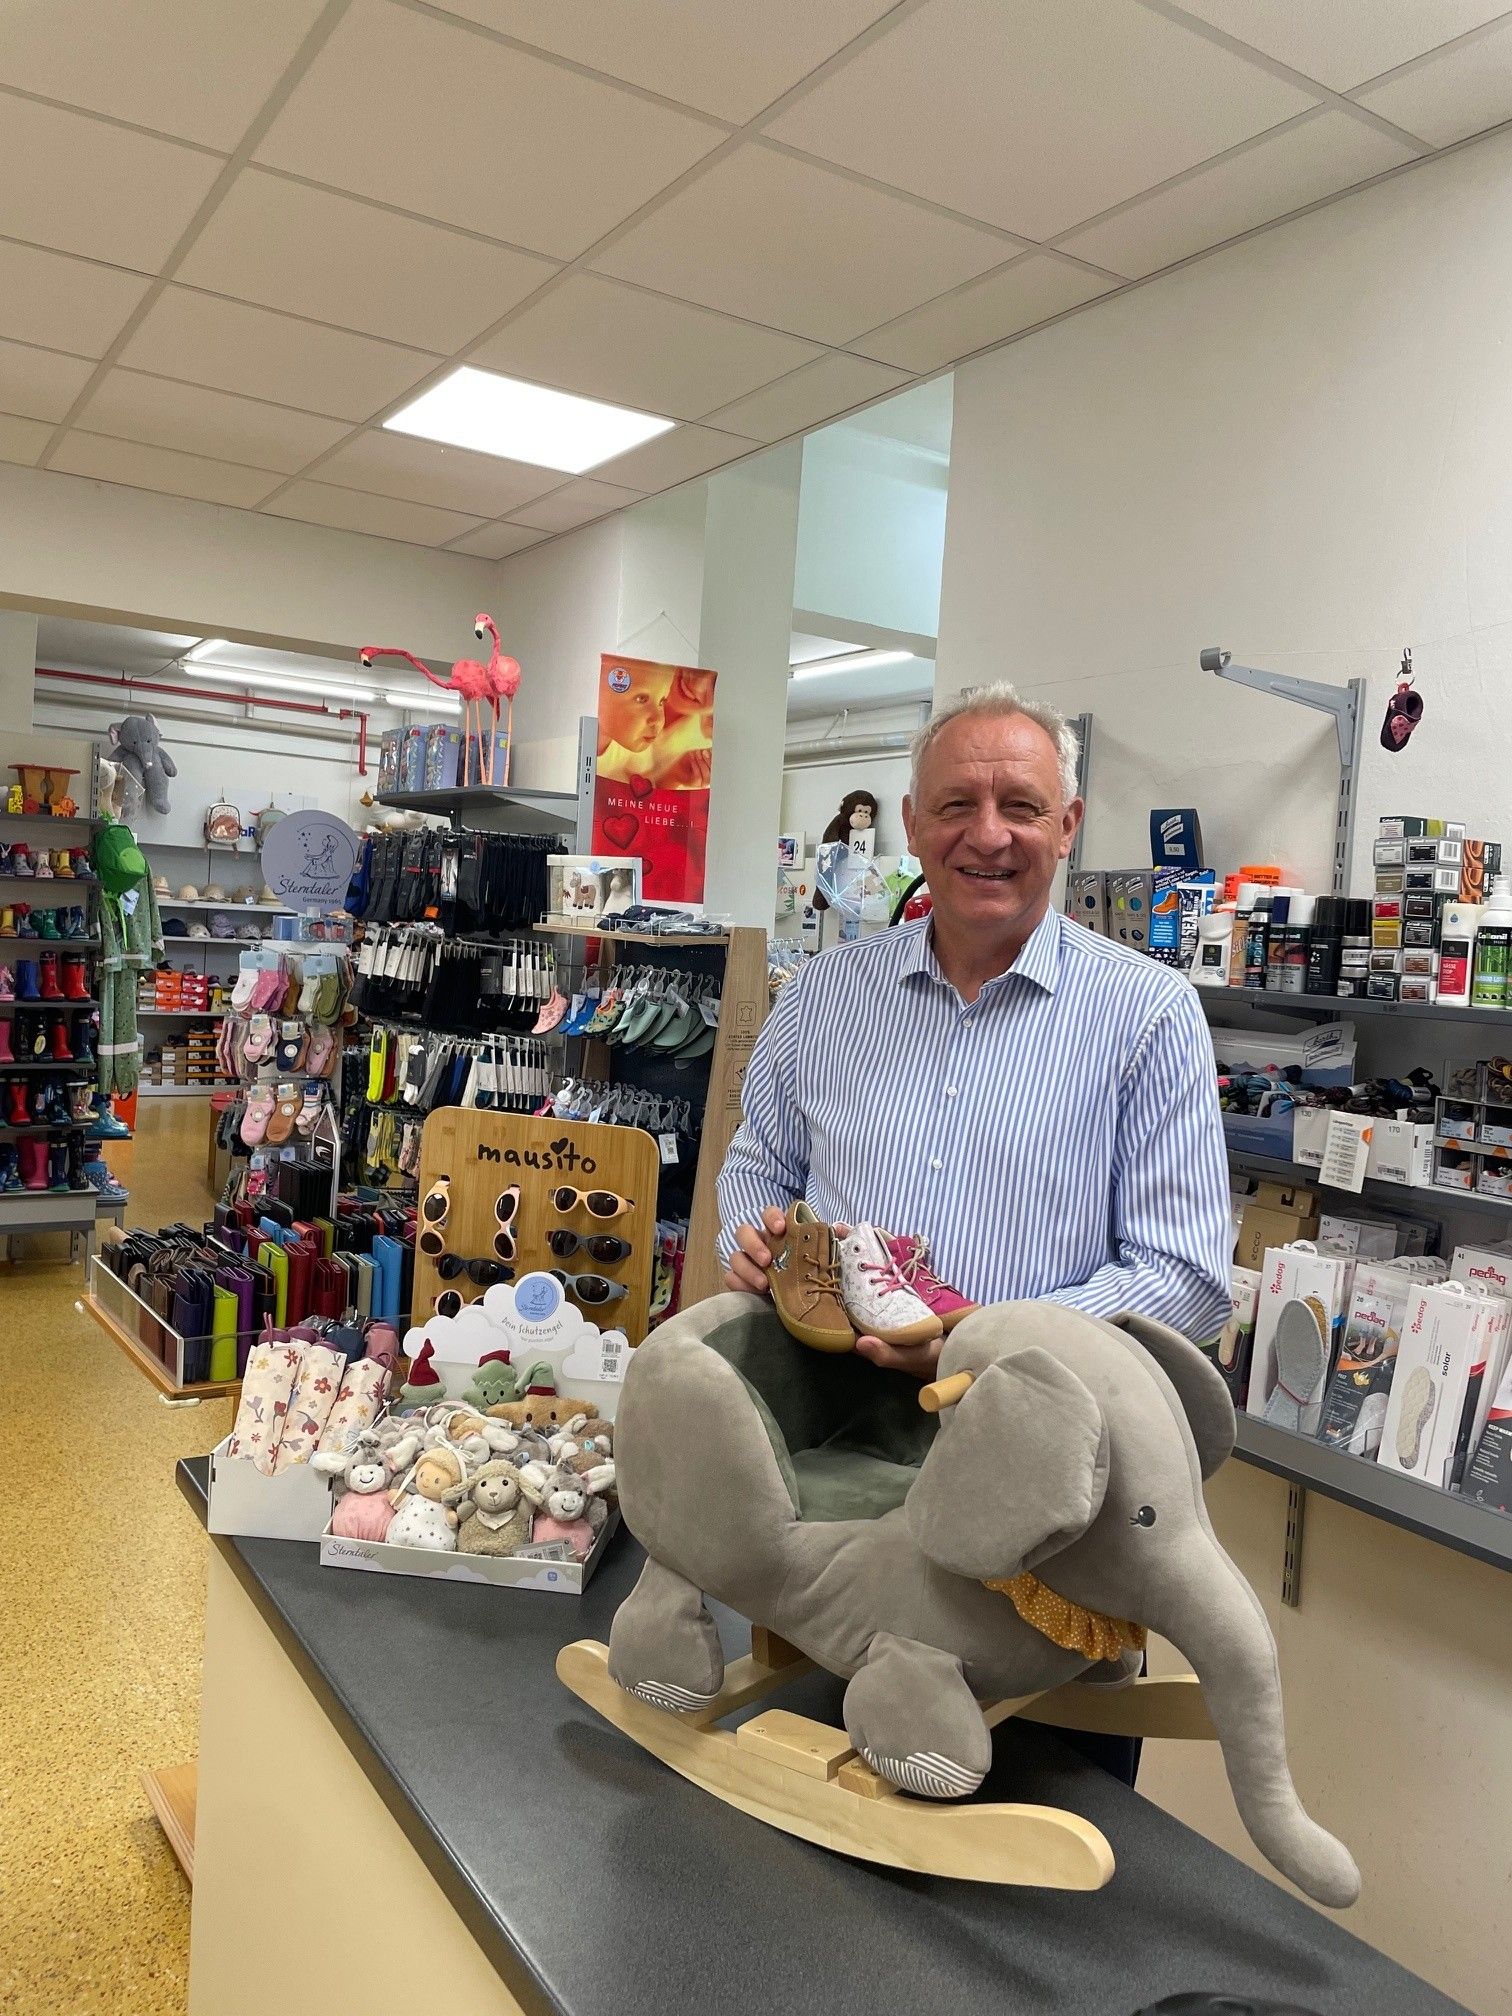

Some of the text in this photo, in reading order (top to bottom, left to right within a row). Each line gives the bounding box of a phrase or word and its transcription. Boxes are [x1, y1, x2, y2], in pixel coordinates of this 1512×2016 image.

[608, 798, 678, 813] MEINE NEUE
[853, 840, 866, 854] 24
[273, 879, 339, 896] Sterntaler
[478, 1138, 597, 1174] mausito
[1251, 1231, 1261, 1260] ecco
[1275, 1262, 1285, 1291] pedag
[1469, 1267, 1507, 1285] pedag
[1354, 1310, 1386, 1327] pedag
[1416, 1300, 1428, 1330] pedag
[501, 1316, 563, 1335] Dein Schutzengel
[1441, 1352, 1451, 1376] solar
[328, 1543, 378, 1560] Sterntaler
